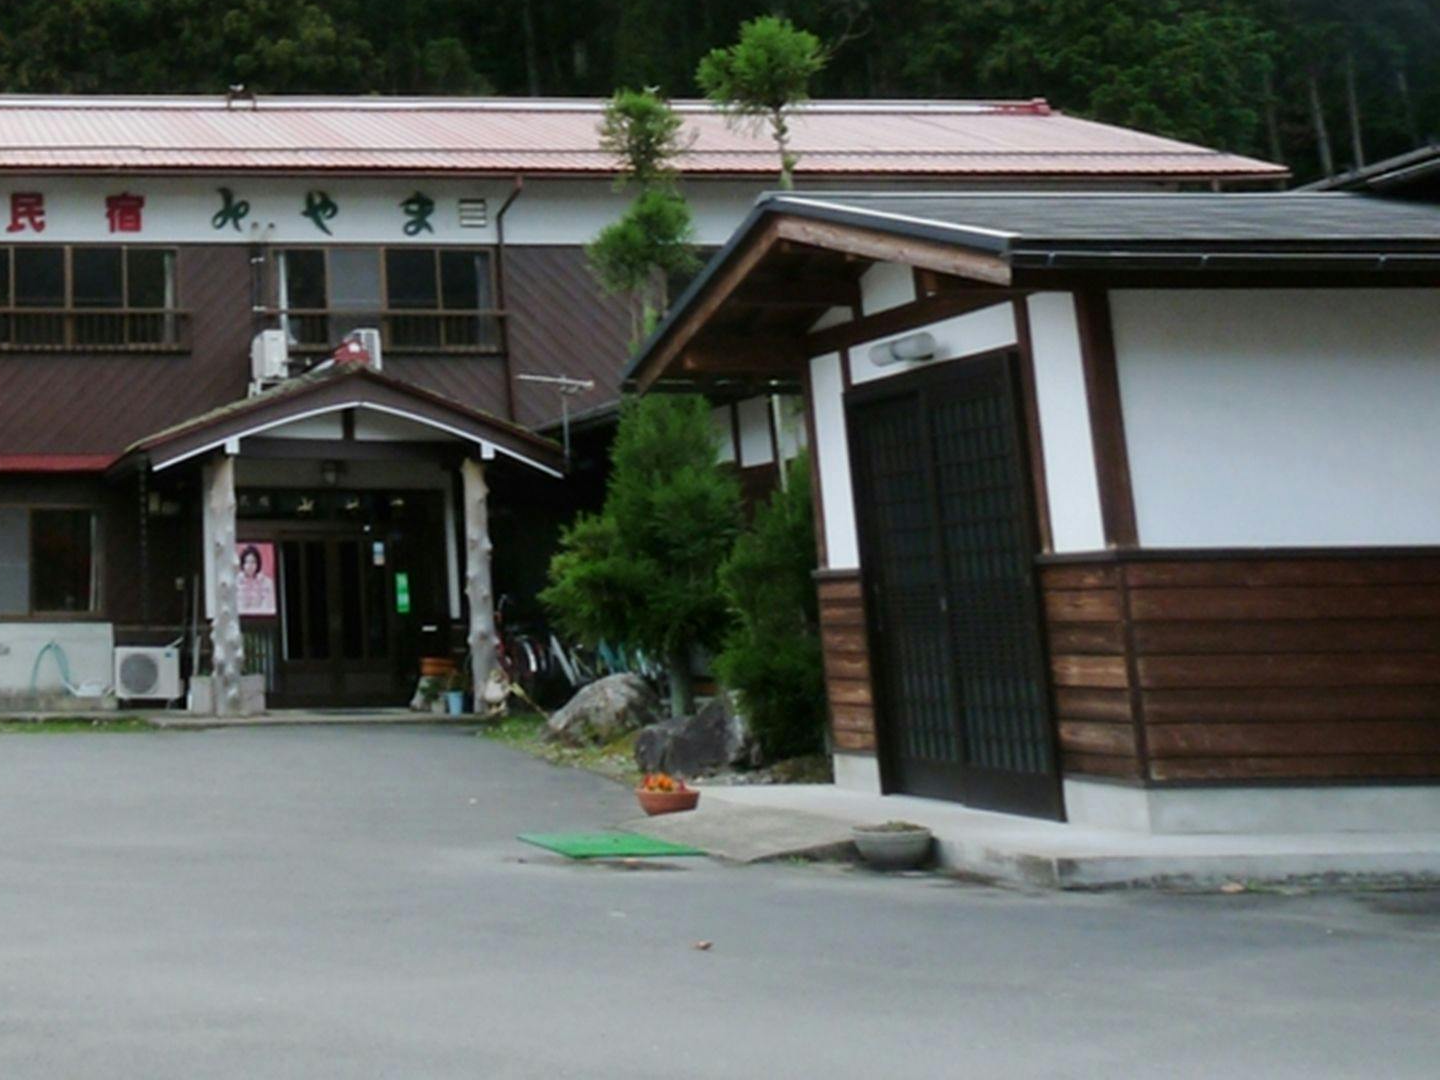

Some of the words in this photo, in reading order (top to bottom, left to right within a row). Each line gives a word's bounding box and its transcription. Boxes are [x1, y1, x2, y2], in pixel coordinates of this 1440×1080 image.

[5, 191, 145, 234] 民宿
[211, 186, 436, 236] みやま
